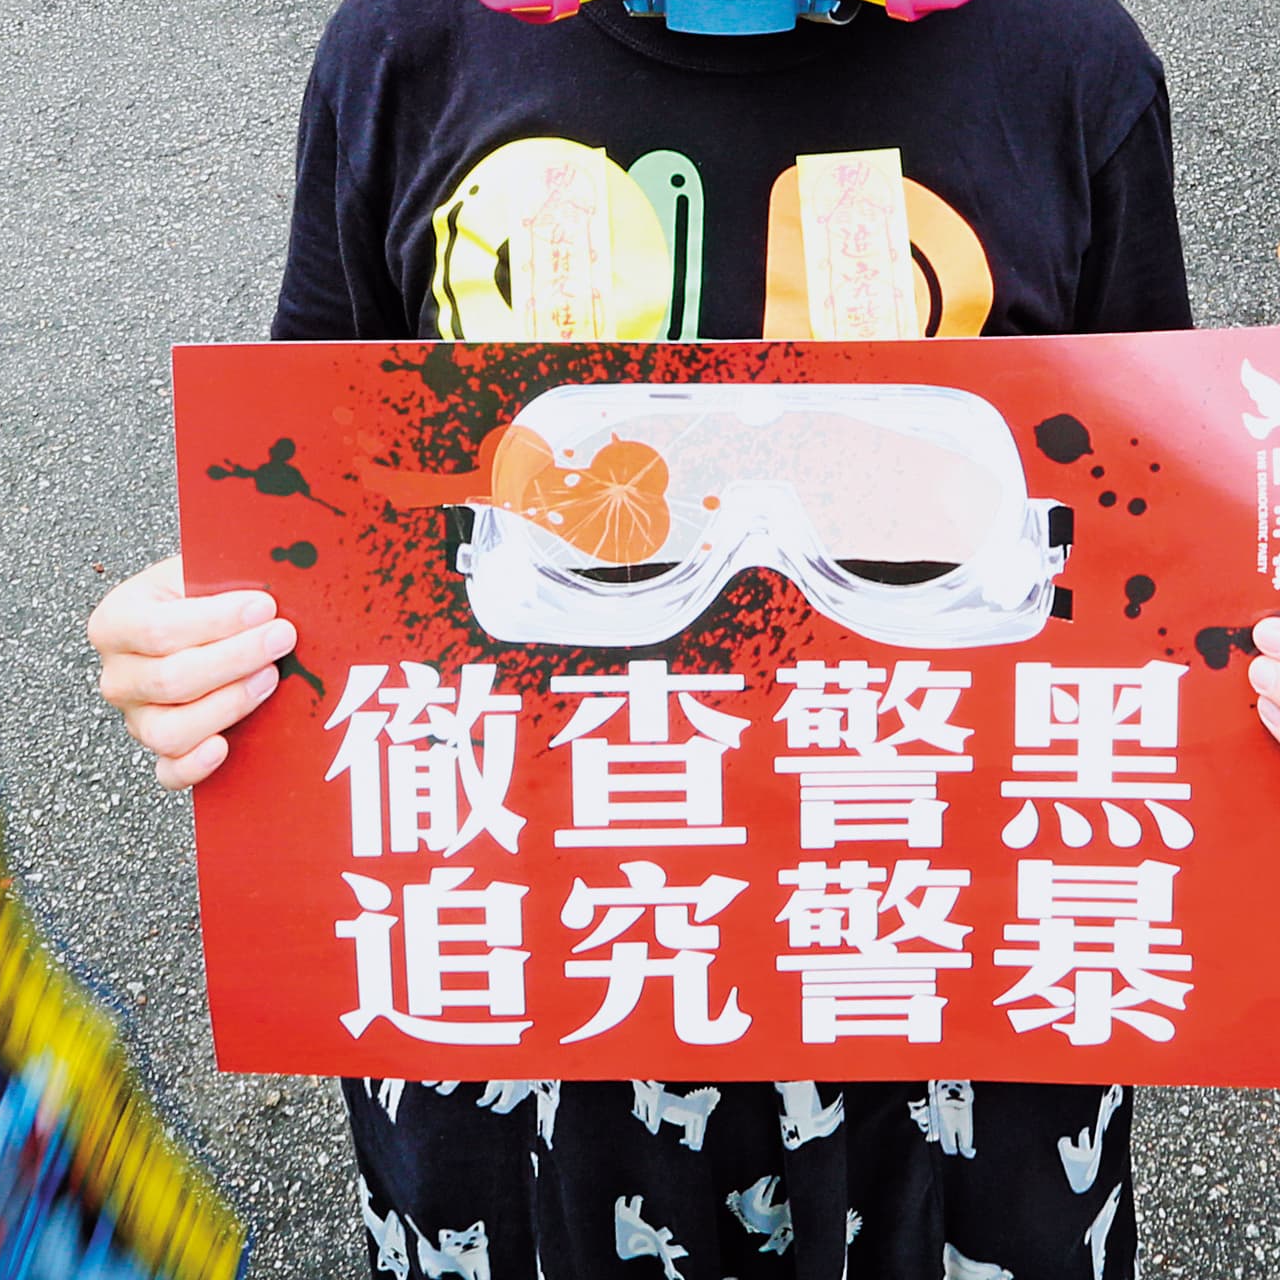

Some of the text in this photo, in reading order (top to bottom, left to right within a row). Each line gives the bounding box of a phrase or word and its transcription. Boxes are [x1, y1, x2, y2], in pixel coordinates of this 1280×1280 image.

[324, 659, 1195, 857] 徹查警黑
[333, 858, 1195, 1046] 追究警暴
